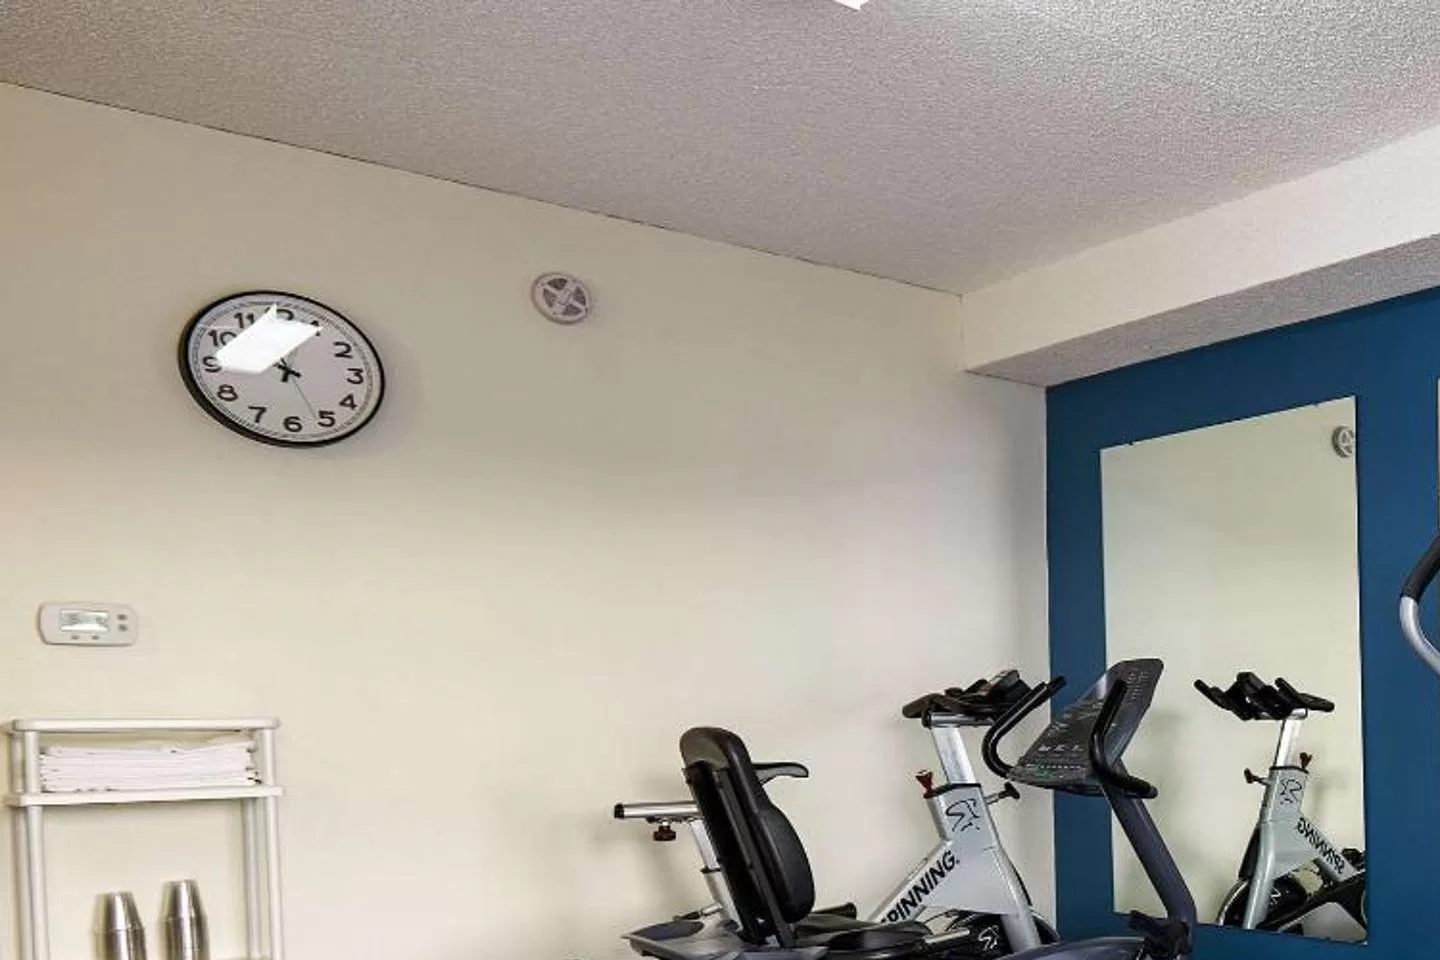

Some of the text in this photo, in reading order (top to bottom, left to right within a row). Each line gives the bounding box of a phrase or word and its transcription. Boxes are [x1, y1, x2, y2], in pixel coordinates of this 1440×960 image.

[333, 341, 353, 359] 2
[347, 368, 364, 385] 3
[217, 384, 239, 402] 8
[339, 394, 358, 411] 4
[248, 406, 267, 424] 7
[317, 410, 336, 427] 5
[283, 416, 303, 433] 6
[880, 849, 957, 923] PINNING
